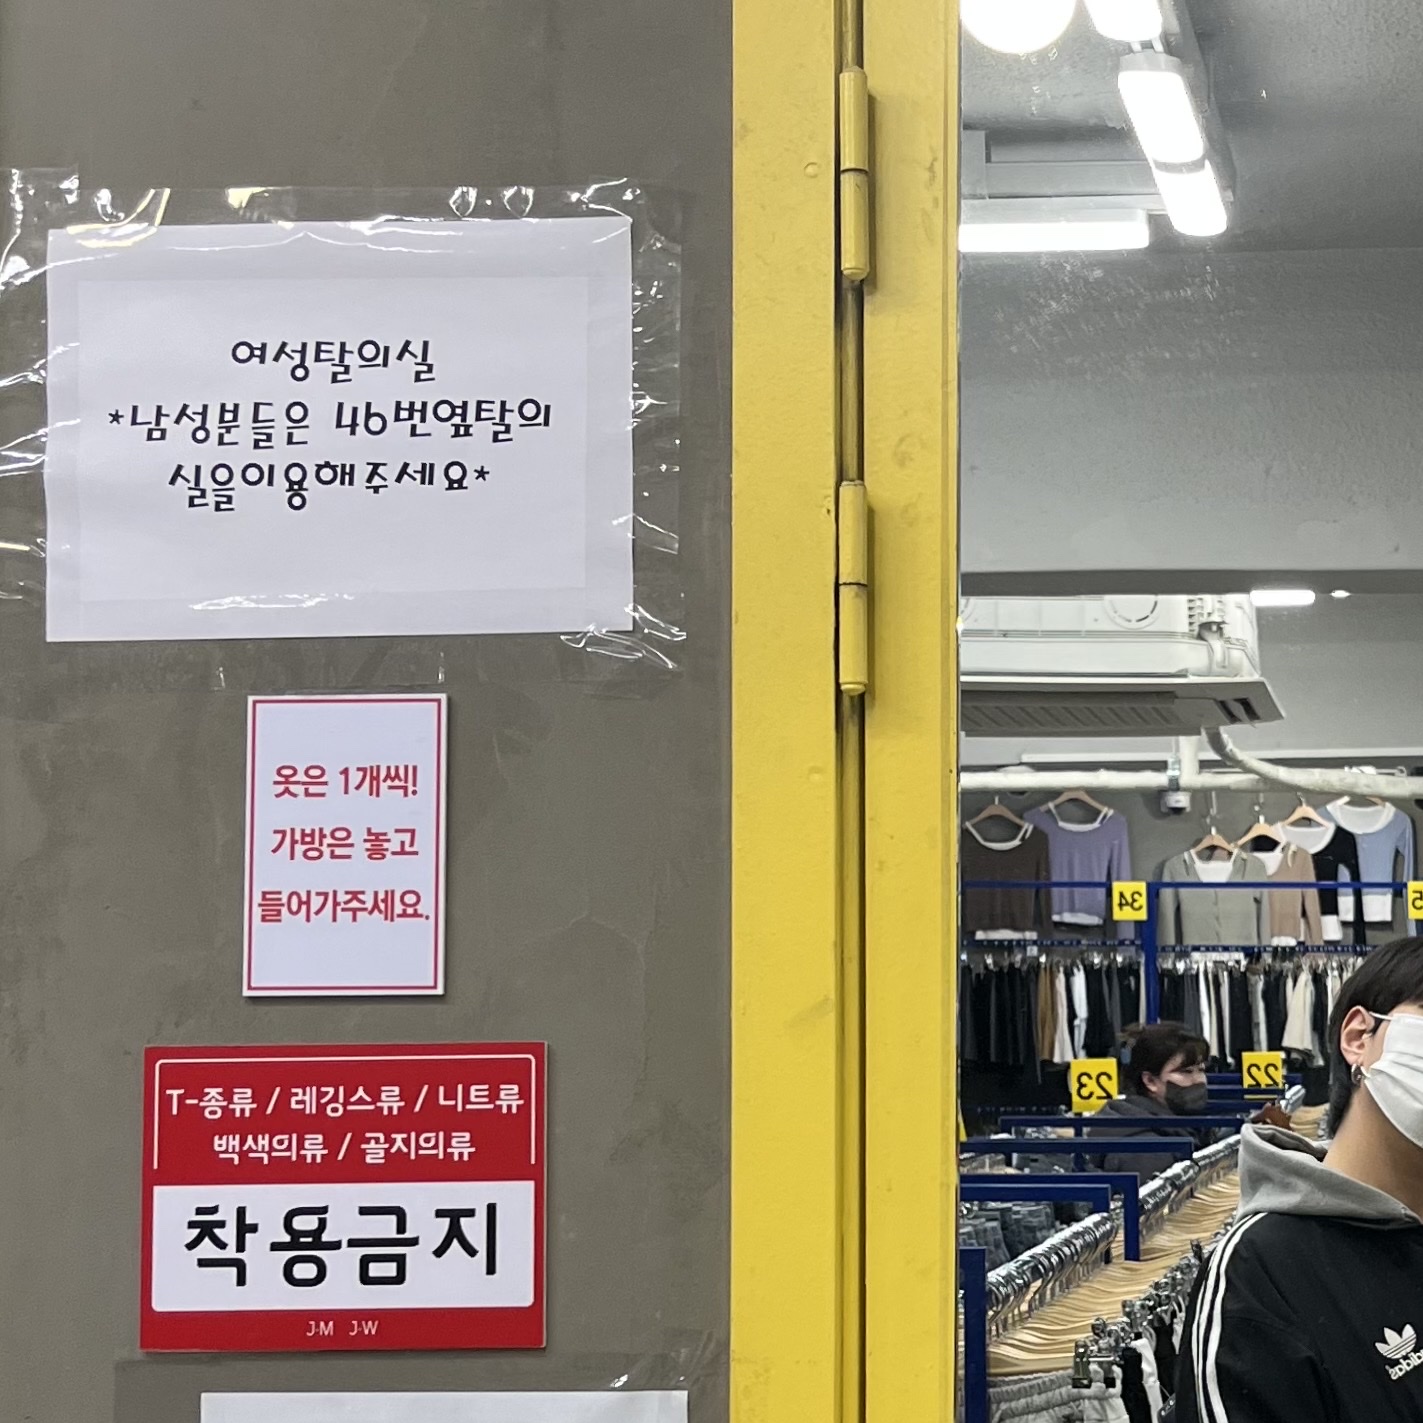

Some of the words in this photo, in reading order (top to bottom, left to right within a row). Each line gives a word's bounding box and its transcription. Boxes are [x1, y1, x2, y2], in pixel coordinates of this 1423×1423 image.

[232, 340, 435, 384] 여성탈의실
[336, 399, 551, 443] 46번옆탈의
[273, 765, 328, 798] 옷은
[339, 765, 417, 797] 1개씩!
[271, 827, 354, 860] 가방은
[363, 827, 418, 860] 놓고
[258, 890, 429, 922] 들어가주세요.
[166, 1088, 257, 1119] T-종류
[291, 1086, 404, 1117] 레깅스류
[439, 1084, 524, 1113] 니트류
[214, 1134, 328, 1164] 백색의류
[361, 1132, 475, 1163] 골지의류
[185, 1203, 496, 1287] 착용금지
